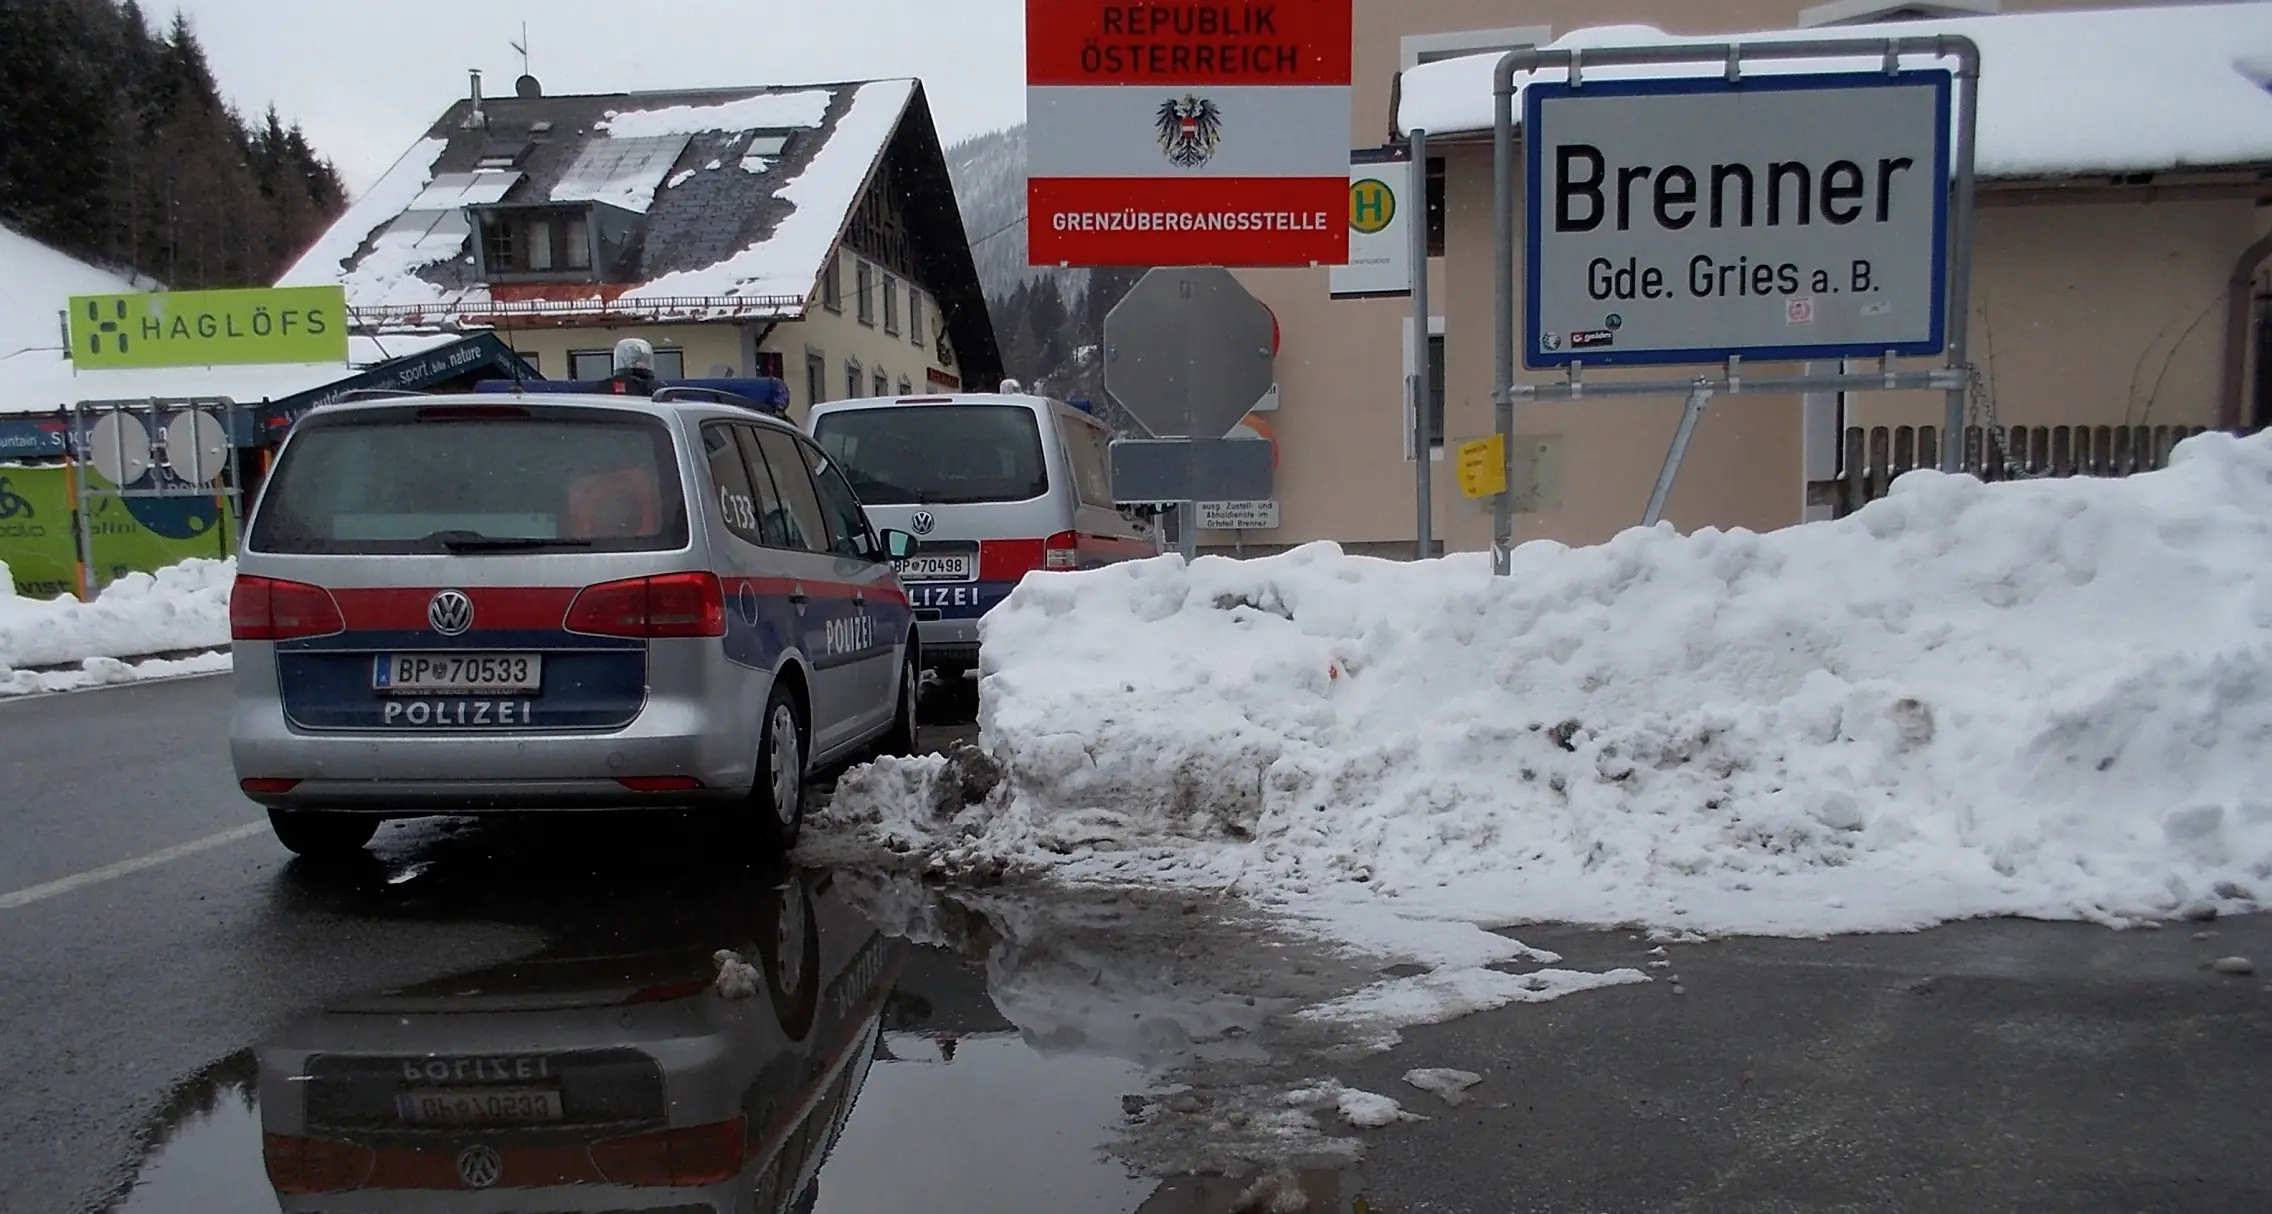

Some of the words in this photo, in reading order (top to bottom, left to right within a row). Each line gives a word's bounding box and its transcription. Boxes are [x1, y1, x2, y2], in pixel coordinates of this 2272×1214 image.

[1103, 6, 1276, 35] REPUBLIK
[1081, 37, 1298, 73] ÖSTERREICH
[1555, 144, 1914, 233] Brenner
[1052, 207, 1328, 231] GRENZÜBERGANGSSTELLE
[1355, 189, 1382, 222] H
[1587, 256, 1674, 300] Gde.
[1688, 254, 1799, 297] Gries
[1811, 268, 1839, 294] a.
[1851, 260, 1880, 293] B.
[141, 306, 326, 340] HAGLÖFS
[400, 360, 429, 386] sport
[449, 345, 482, 368] nature
[0, 435, 38, 448] untain
[730, 493, 755, 530] 133
[1258, 502, 1273, 510] und
[920, 558, 962, 573] 70498
[908, 587, 979, 606] LIZEI
[826, 615, 873, 656] POLIZEI
[398, 658, 430, 683] BP
[450, 658, 528, 683] 70533
[384, 701, 531, 725] POLIZEI
